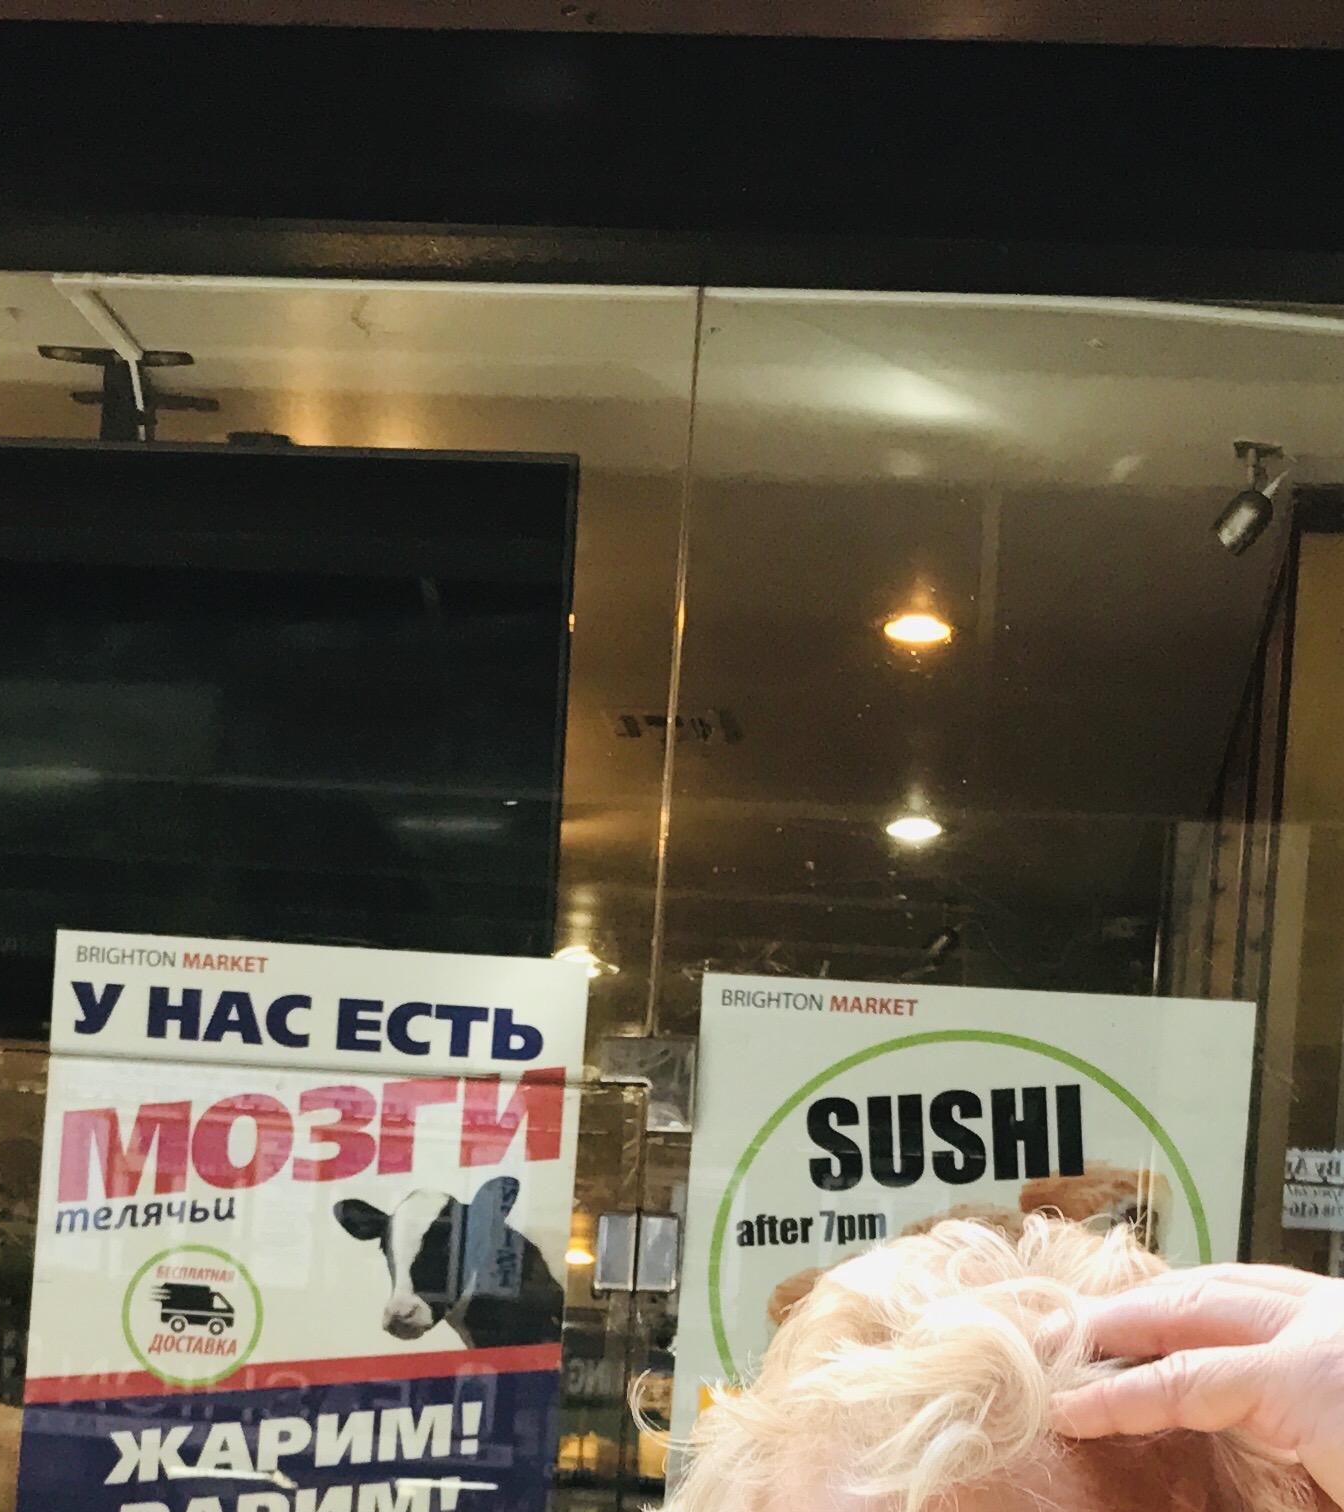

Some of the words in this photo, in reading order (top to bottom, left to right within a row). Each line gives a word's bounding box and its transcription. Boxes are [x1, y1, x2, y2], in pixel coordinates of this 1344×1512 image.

[76, 946, 177, 969] BRIGHTON
[182, 952, 269, 974] MARKET
[71, 981, 125, 1034] У
[146, 986, 312, 1048] НАС
[336, 998, 544, 1061] ЕСТЬ
[721, 989, 824, 1012] BRIGHTON
[830, 995, 919, 1017] MARKET
[58, 1067, 567, 1202] МОЗГИ
[805, 1083, 1085, 1192] SUSHI
[56, 1196, 236, 1235] телячьи
[735, 1212, 811, 1248] after
[819, 1208, 888, 1246] 7pm
[156, 1265, 236, 1282] БЕСПЛАТНАЯ
[148, 1333, 238, 1358] ДОСТАВКА
[104, 1401, 484, 1485] ЖАРИМ!
